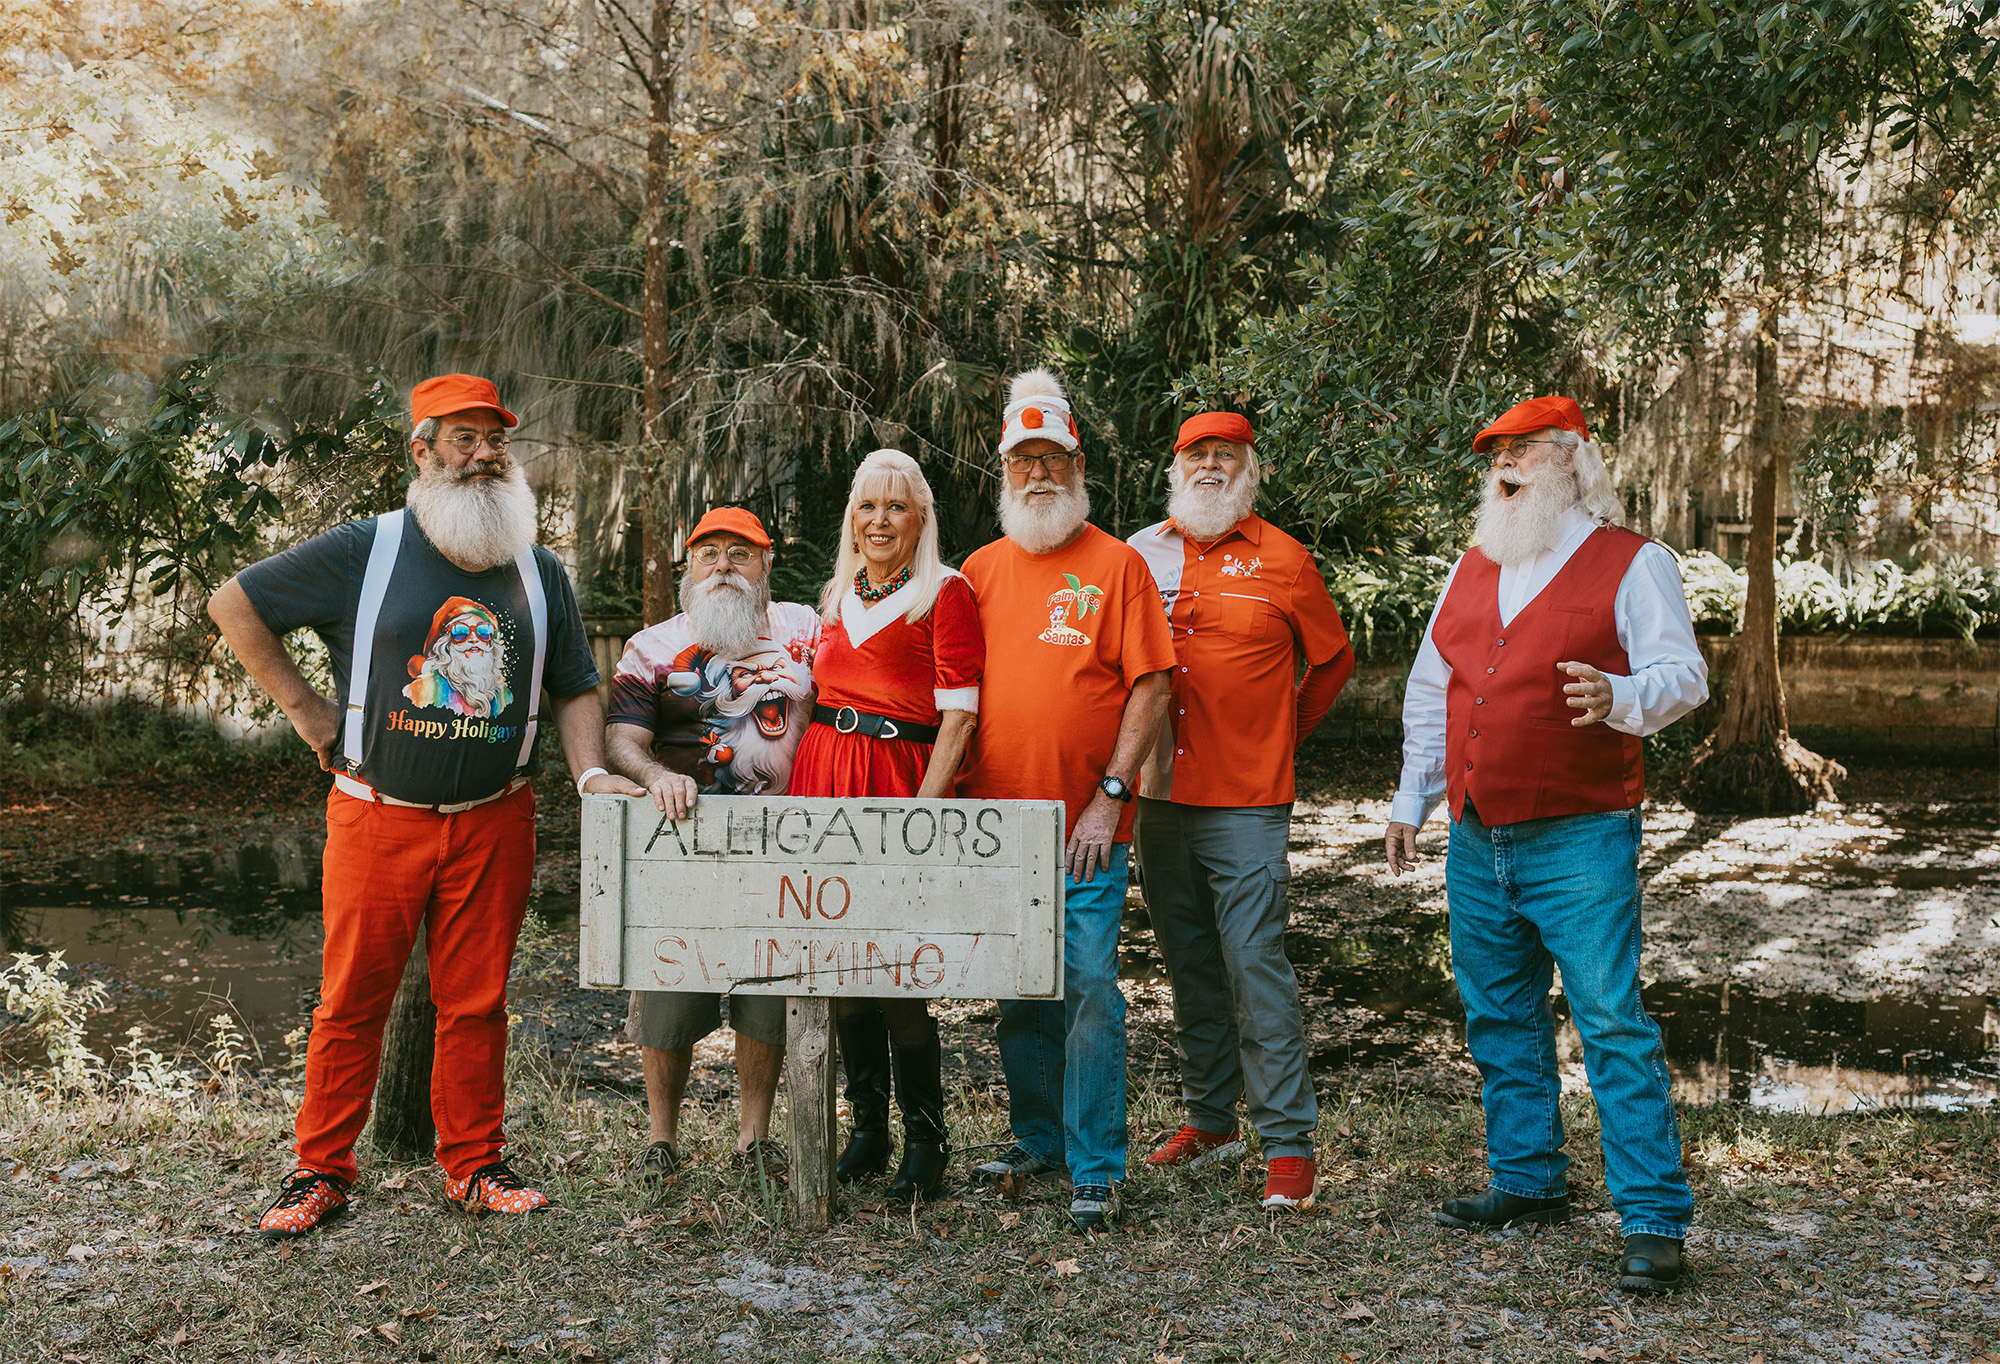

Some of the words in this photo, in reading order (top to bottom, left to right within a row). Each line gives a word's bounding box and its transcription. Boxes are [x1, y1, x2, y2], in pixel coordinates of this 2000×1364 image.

[1047, 591, 1075, 606] Palm
[1077, 590, 1100, 609] Tree
[1043, 628, 1086, 645] Santas
[386, 709, 448, 739] Happy
[449, 717, 517, 744] Holigays
[644, 806, 1003, 857] ALLIGATORS
[778, 874, 851, 921] NO
